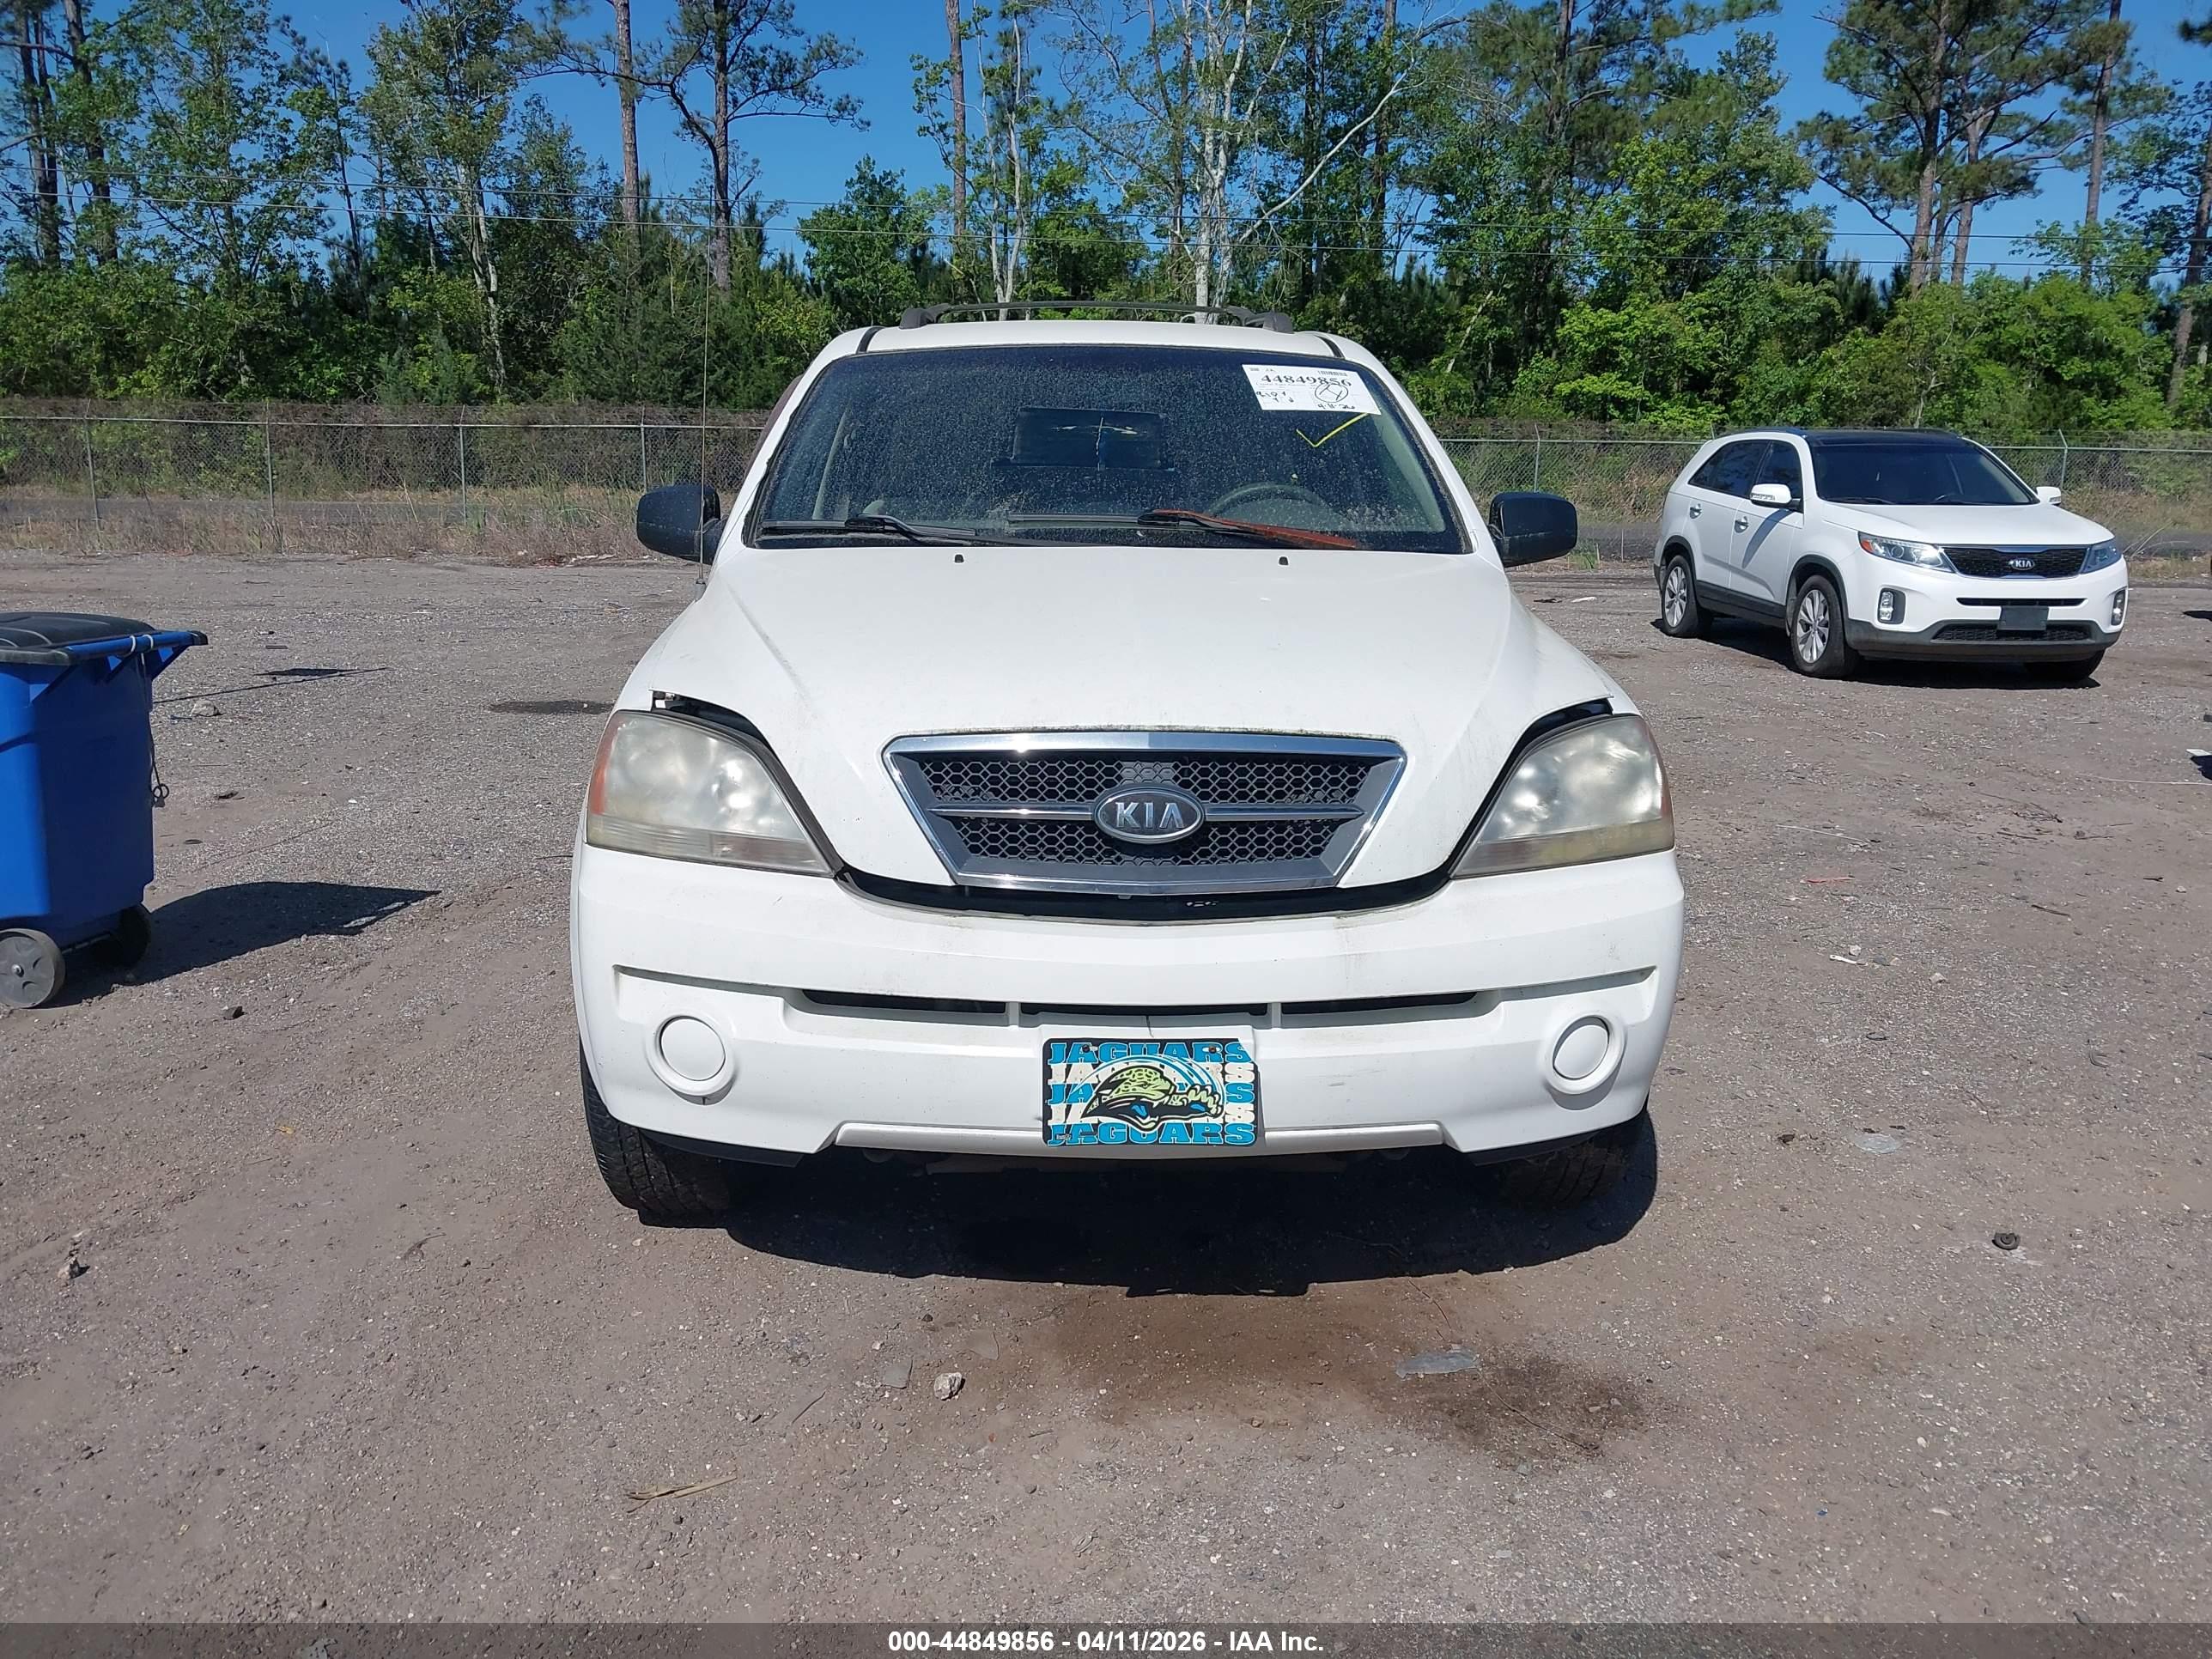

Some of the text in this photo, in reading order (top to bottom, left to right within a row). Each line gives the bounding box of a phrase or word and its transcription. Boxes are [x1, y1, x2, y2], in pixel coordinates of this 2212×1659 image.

[1261, 374, 1352, 386] 44849856
[1115, 802, 1185, 830] KIA
[1048, 1042, 1253, 1065] JAGUARS
[1047, 1122, 1255, 1146] JAGUARS
